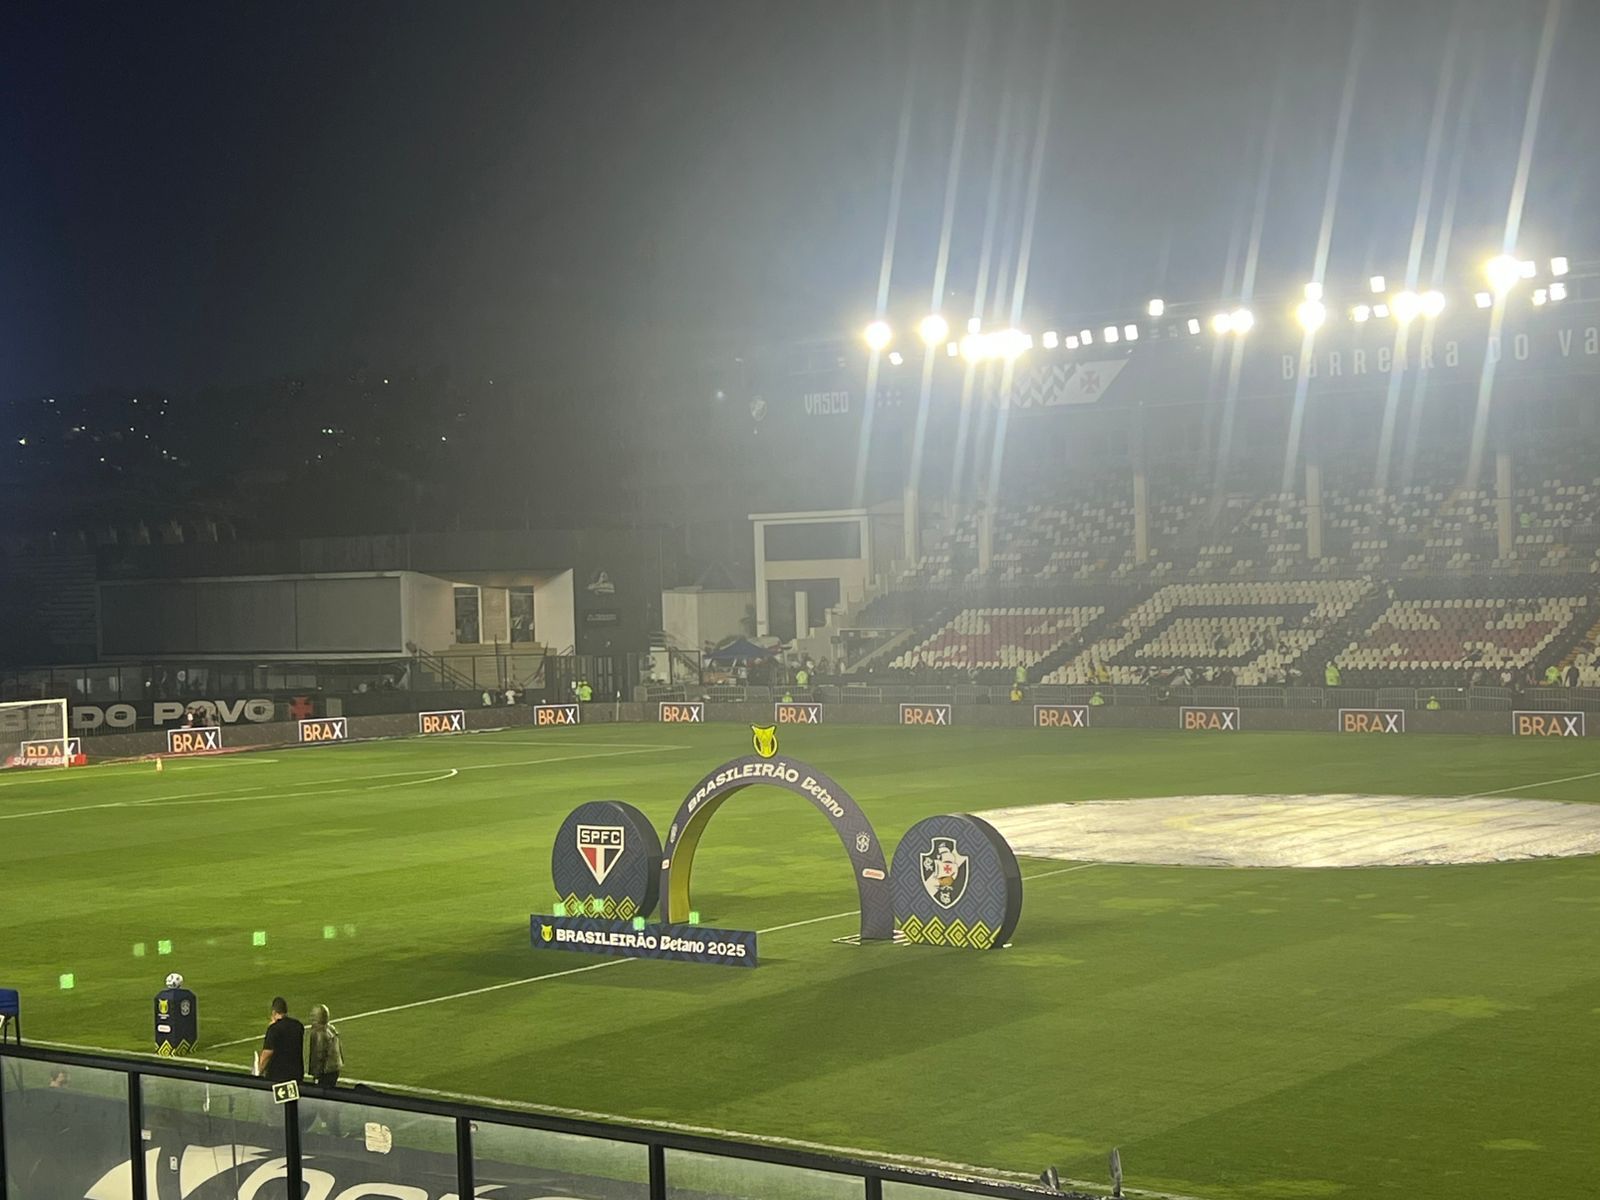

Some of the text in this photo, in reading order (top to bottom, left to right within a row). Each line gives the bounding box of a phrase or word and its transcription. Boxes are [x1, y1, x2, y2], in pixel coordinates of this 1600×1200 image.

[804, 392, 849, 415] VASCO
[72, 704, 137, 729] DO
[423, 714, 461, 733] BRAX
[538, 708, 576, 725] BRAX
[663, 706, 700, 722] BRAX
[779, 706, 818, 723] BRAX
[905, 708, 946, 725] BRAX
[1039, 710, 1084, 727] BRAX
[1185, 712, 1234, 730] BRAX
[1344, 714, 1398, 733] BRAX
[303, 721, 343, 742] BRAX
[1519, 716, 1578, 736] BRAX
[173, 732, 217, 752] BRAX
[688, 762, 844, 818] BRASILEIRÃO Betano
[581, 830, 622, 845] SPFC
[556, 929, 746, 958] BRASILEIRÃO Betano 2025
